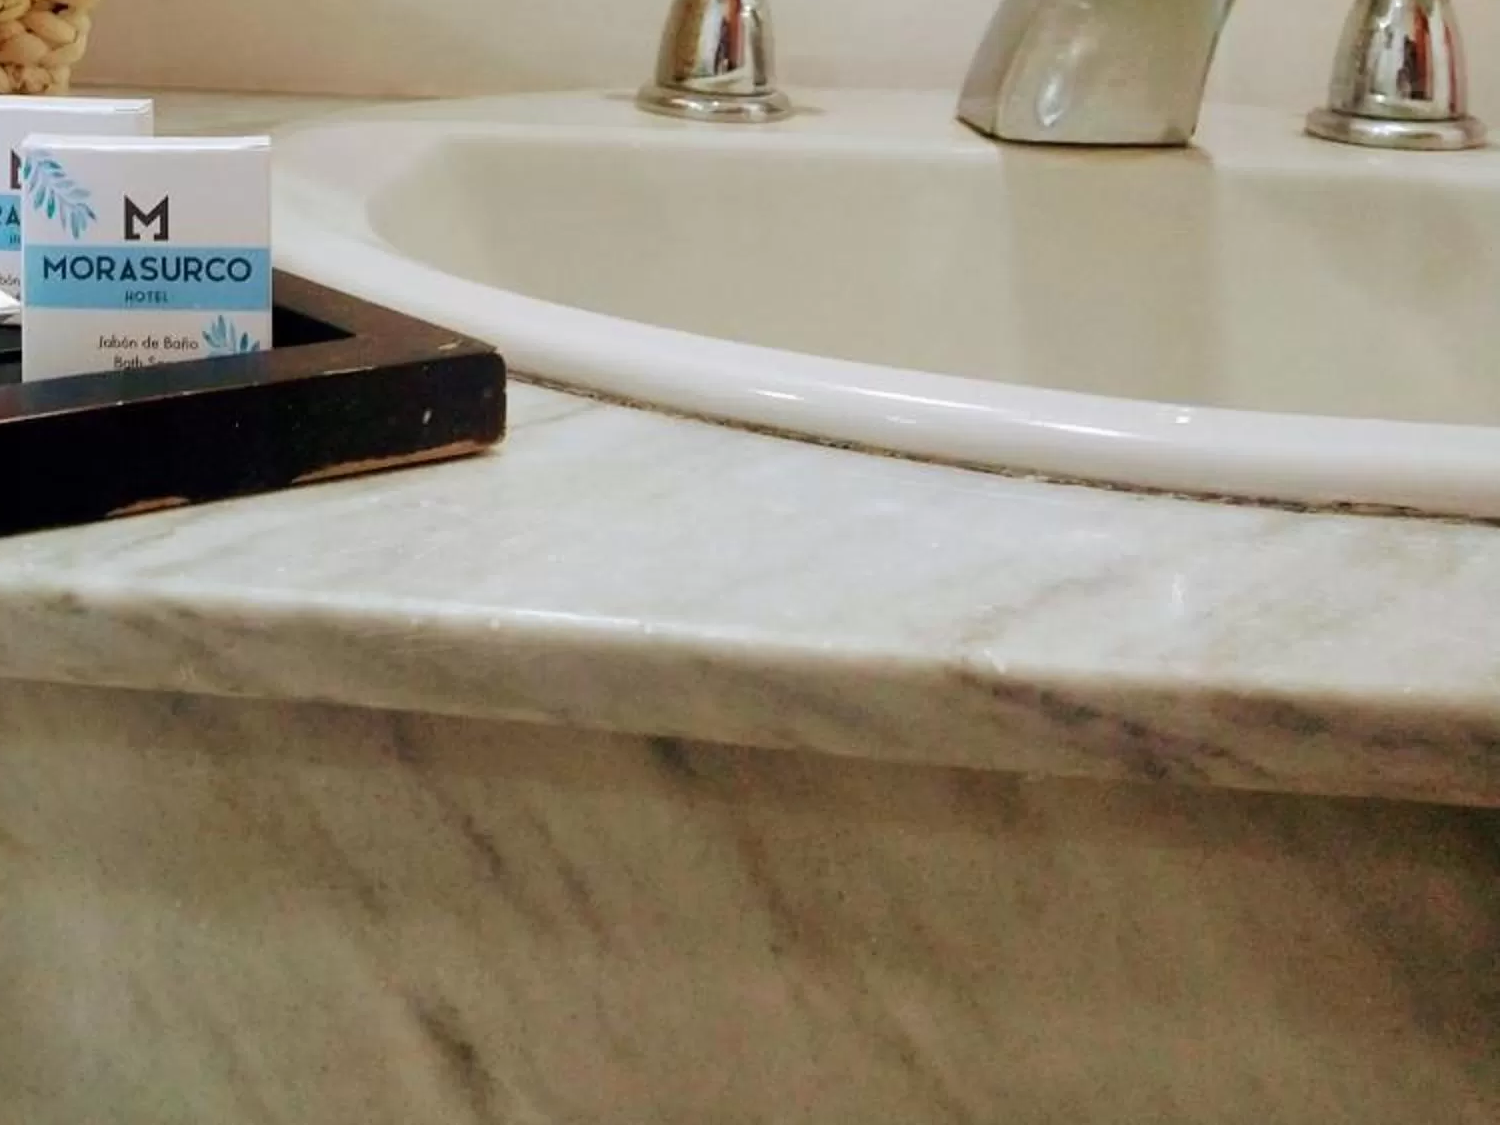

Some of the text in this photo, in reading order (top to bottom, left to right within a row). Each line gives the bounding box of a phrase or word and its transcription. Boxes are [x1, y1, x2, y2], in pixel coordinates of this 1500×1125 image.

[124, 194, 169, 241] M
[43, 255, 253, 282] MORASURCO
[124, 290, 169, 303] HOTEL
[98, 335, 199, 351] Jabón de Baño
